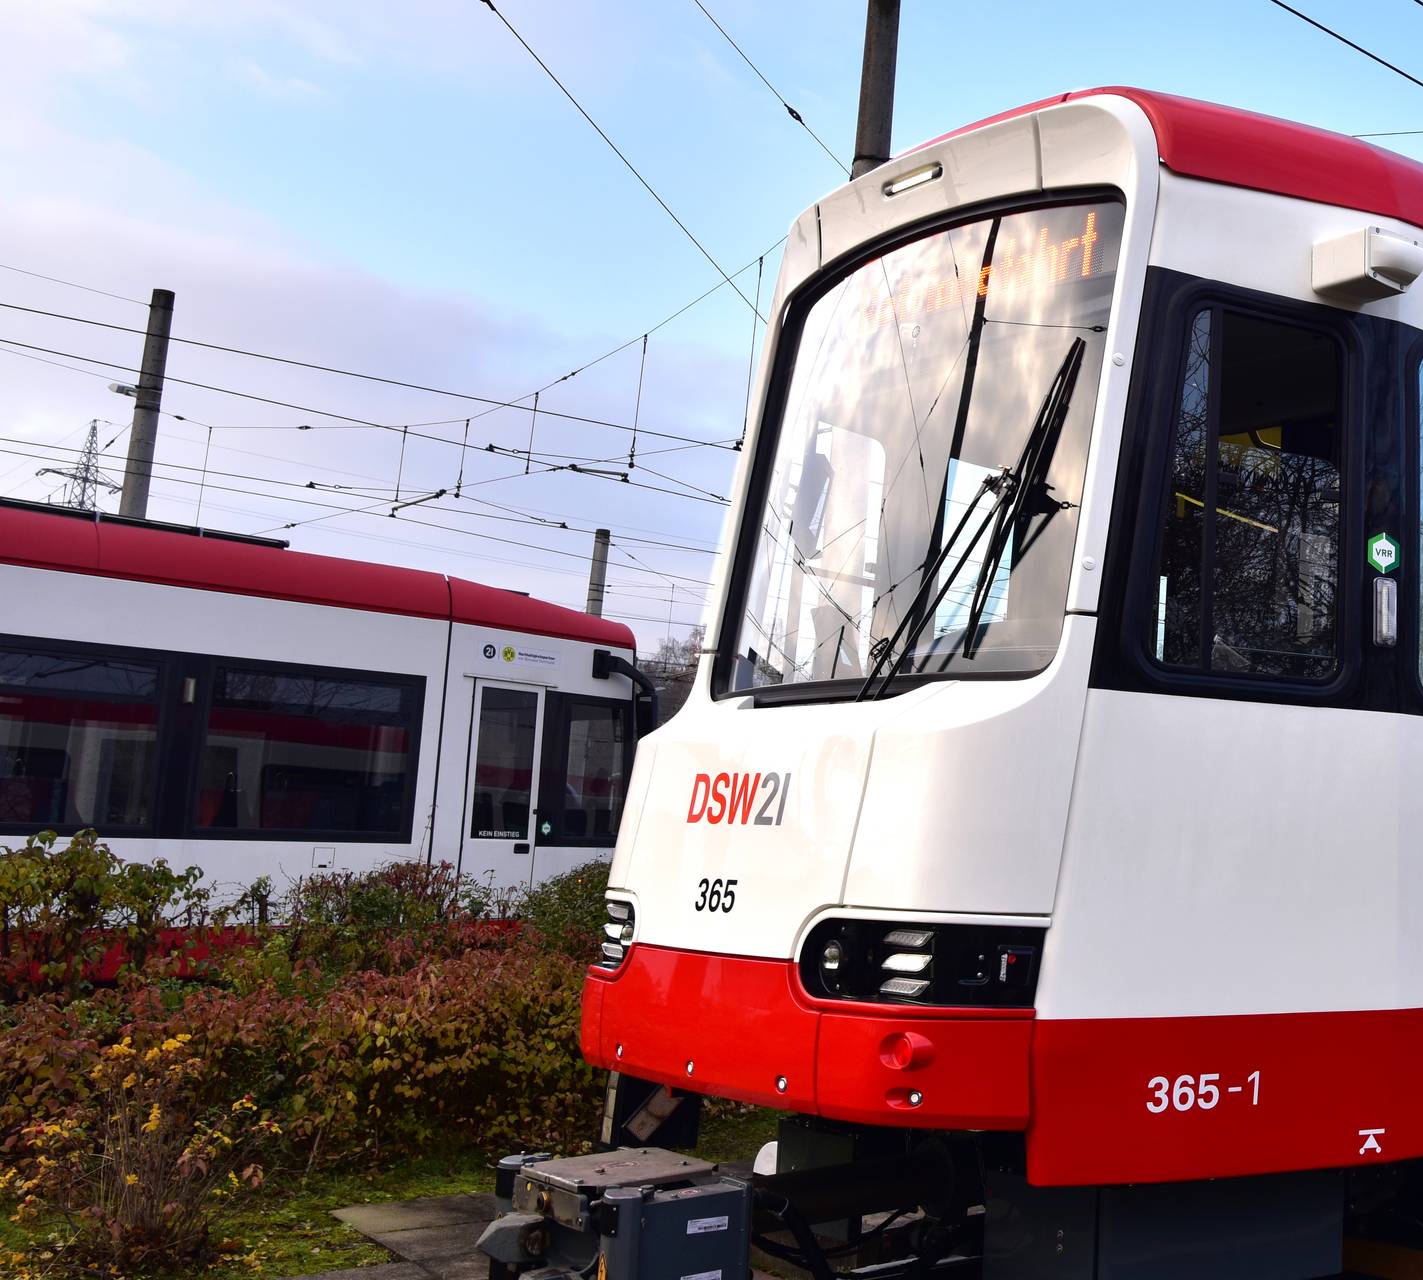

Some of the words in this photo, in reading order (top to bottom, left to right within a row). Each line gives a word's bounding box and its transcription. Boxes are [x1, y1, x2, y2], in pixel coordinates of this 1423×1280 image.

[1375, 548, 1393, 558] VRR
[687, 772, 791, 826] DSW21
[494, 830, 520, 838] EINSTIEG
[695, 878, 738, 913] 365
